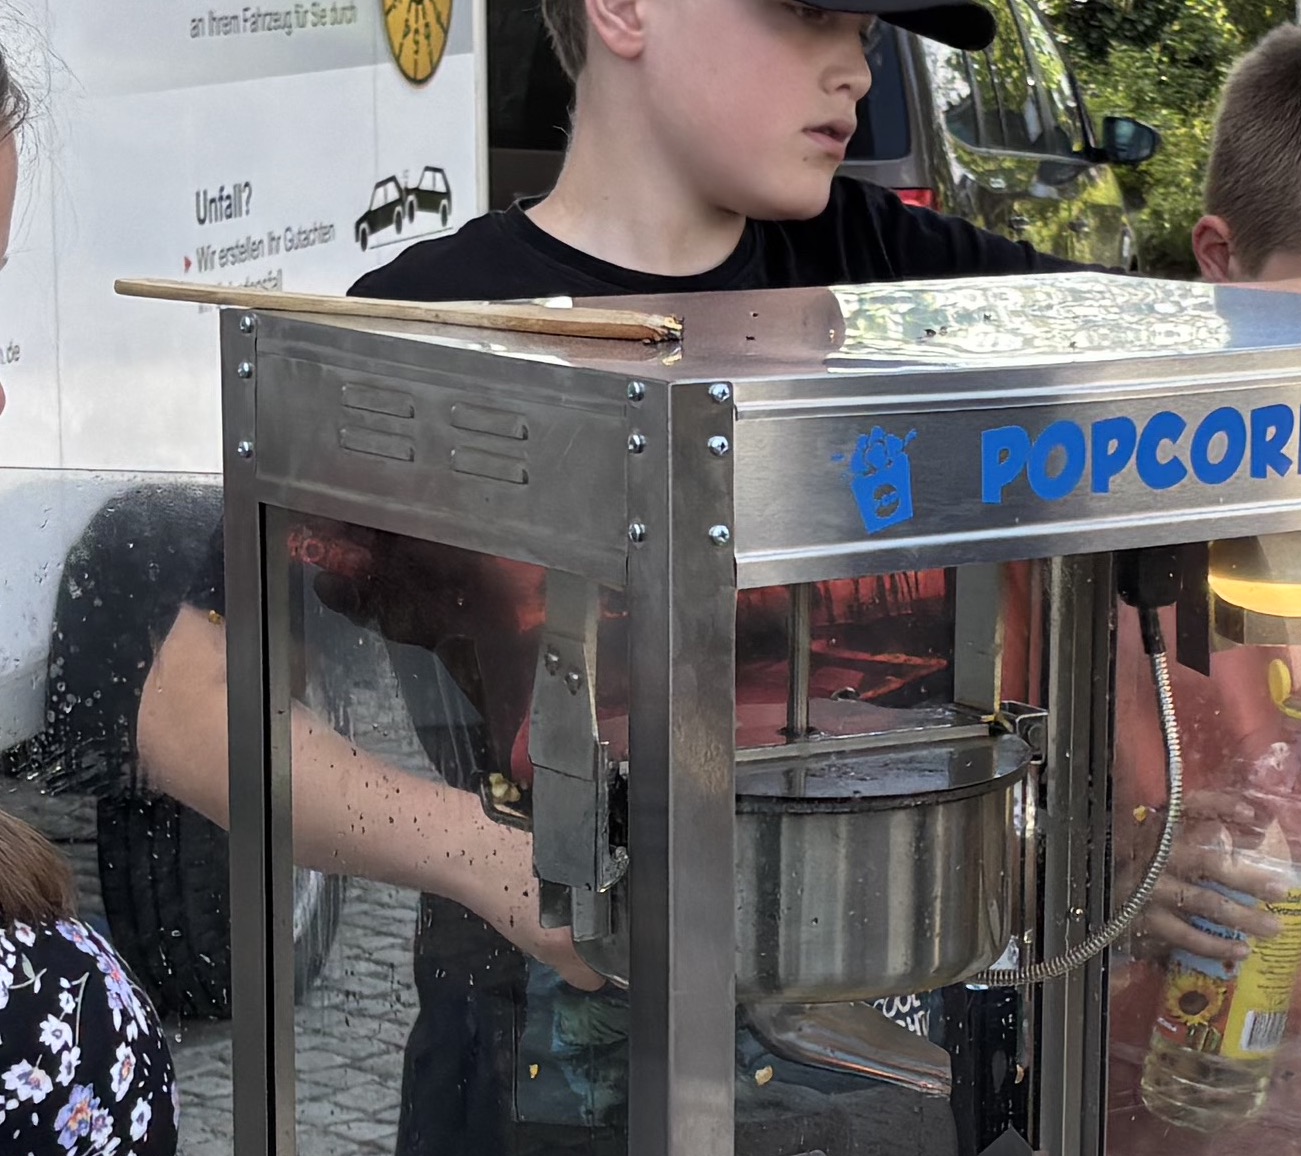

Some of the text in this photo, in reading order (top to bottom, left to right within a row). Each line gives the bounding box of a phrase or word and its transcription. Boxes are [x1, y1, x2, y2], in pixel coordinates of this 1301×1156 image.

[195, 181, 252, 225] Unfall?
[196, 244, 217, 273] Wir
[218, 234, 265, 268] erstellen
[284, 221, 336, 252] Gutachten
